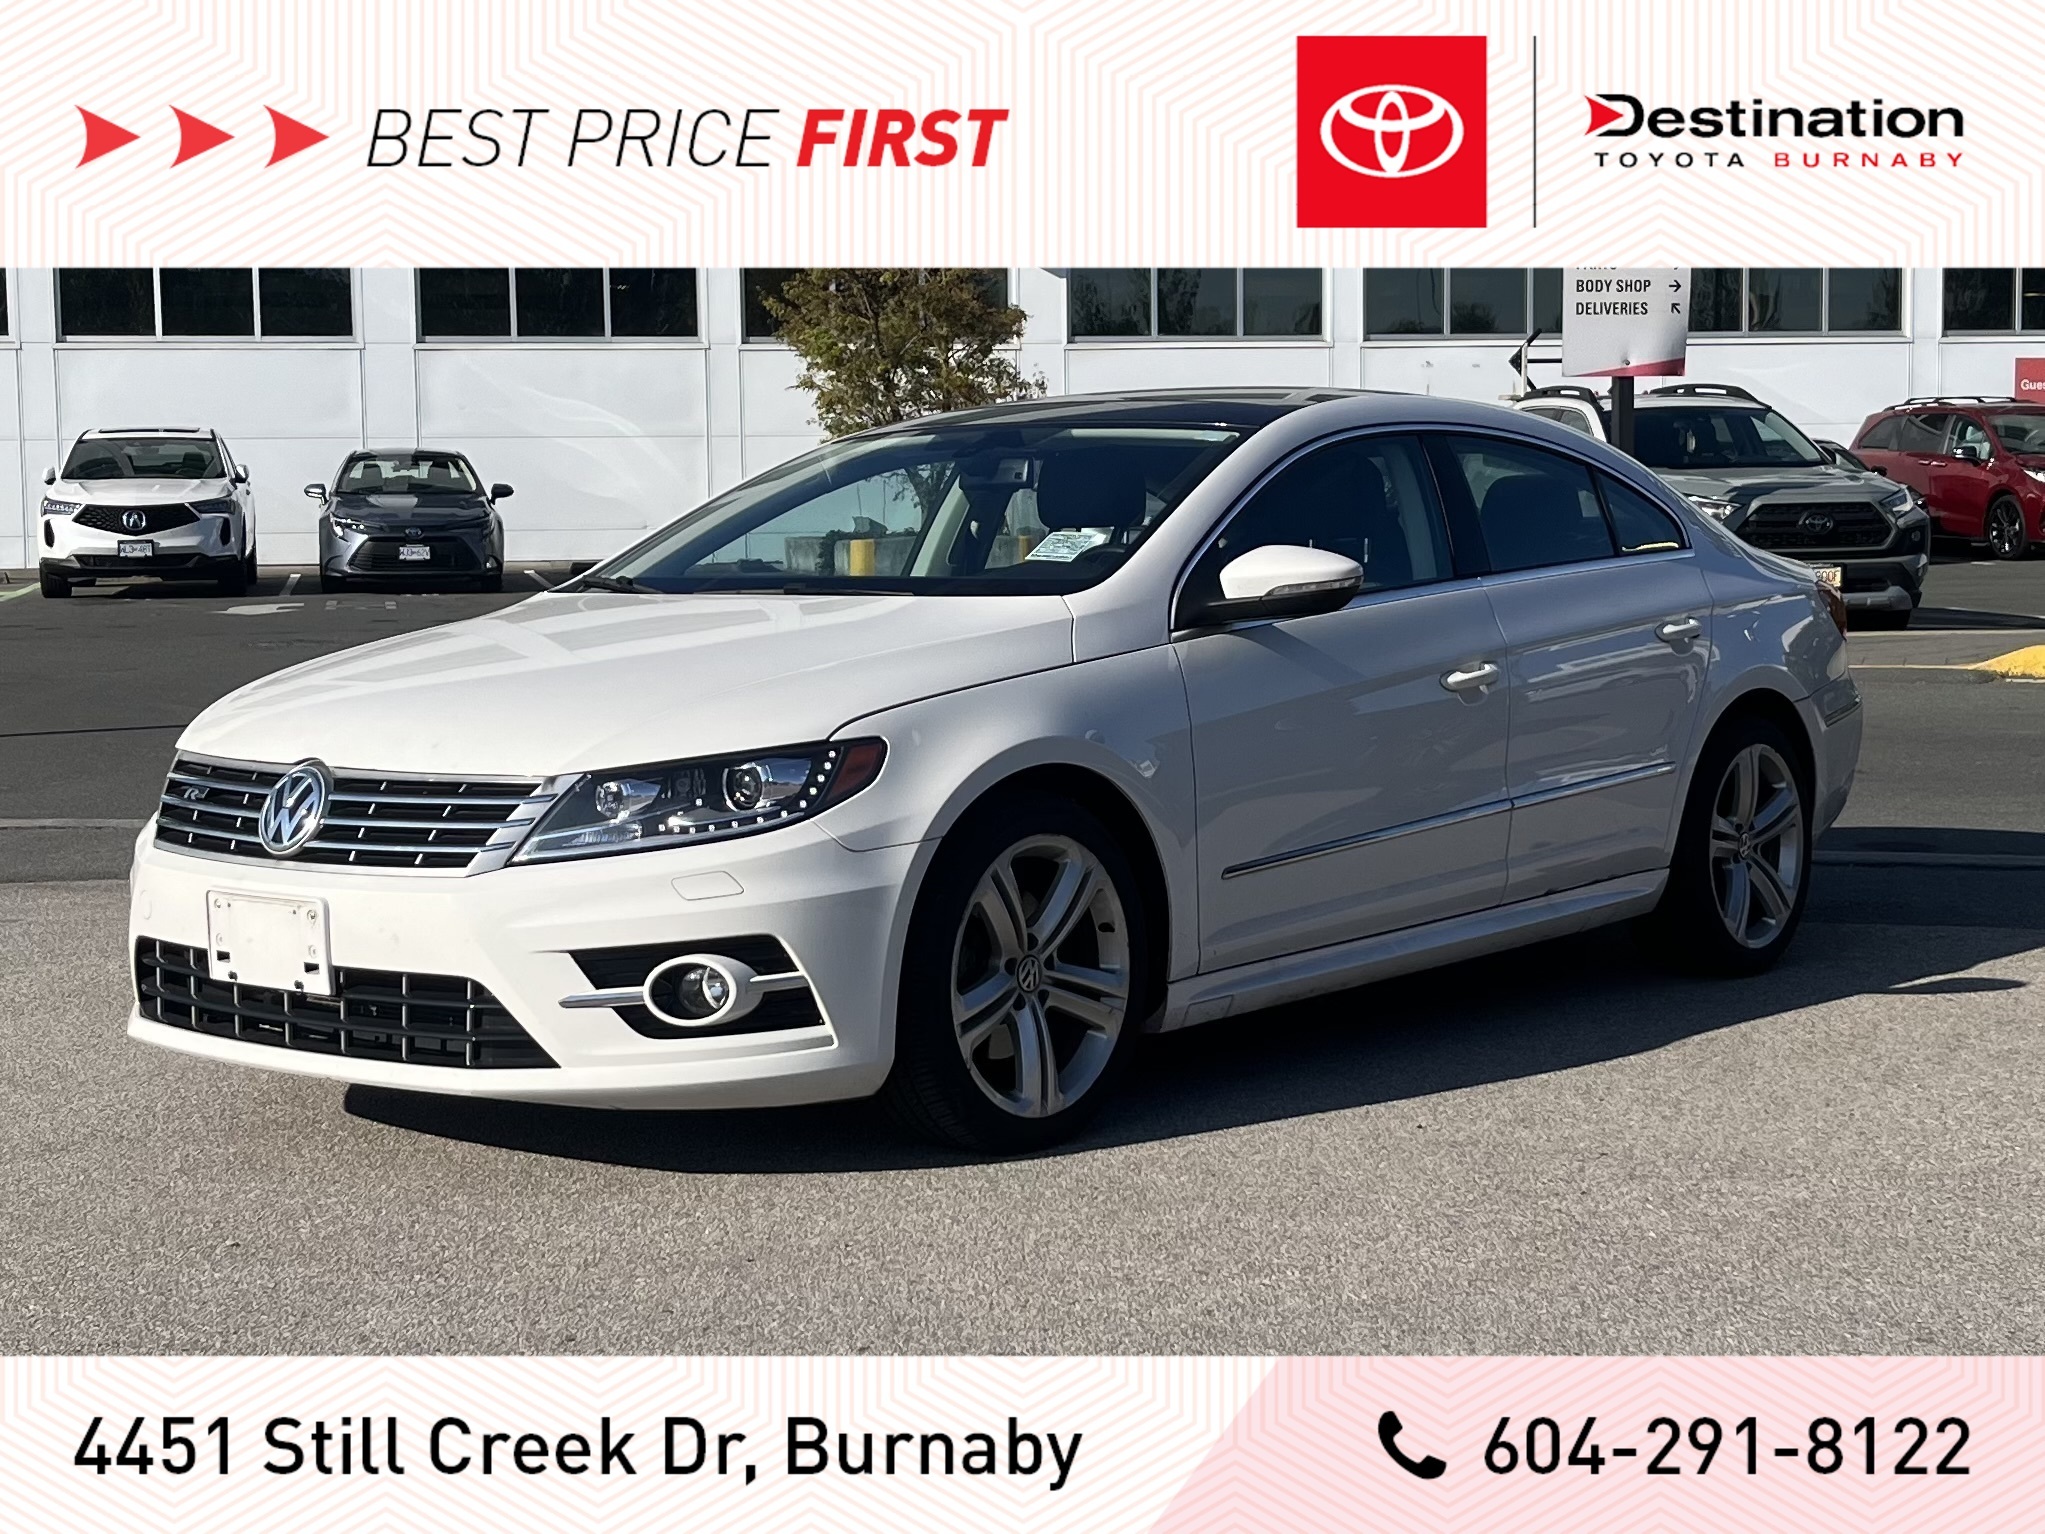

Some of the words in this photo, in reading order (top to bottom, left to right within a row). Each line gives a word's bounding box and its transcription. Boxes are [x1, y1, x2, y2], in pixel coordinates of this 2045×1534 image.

[1575, 279, 1612, 293] BODY
[1615, 279, 1651, 293] SHOP
[1575, 302, 1648, 316] DELIVERIES
